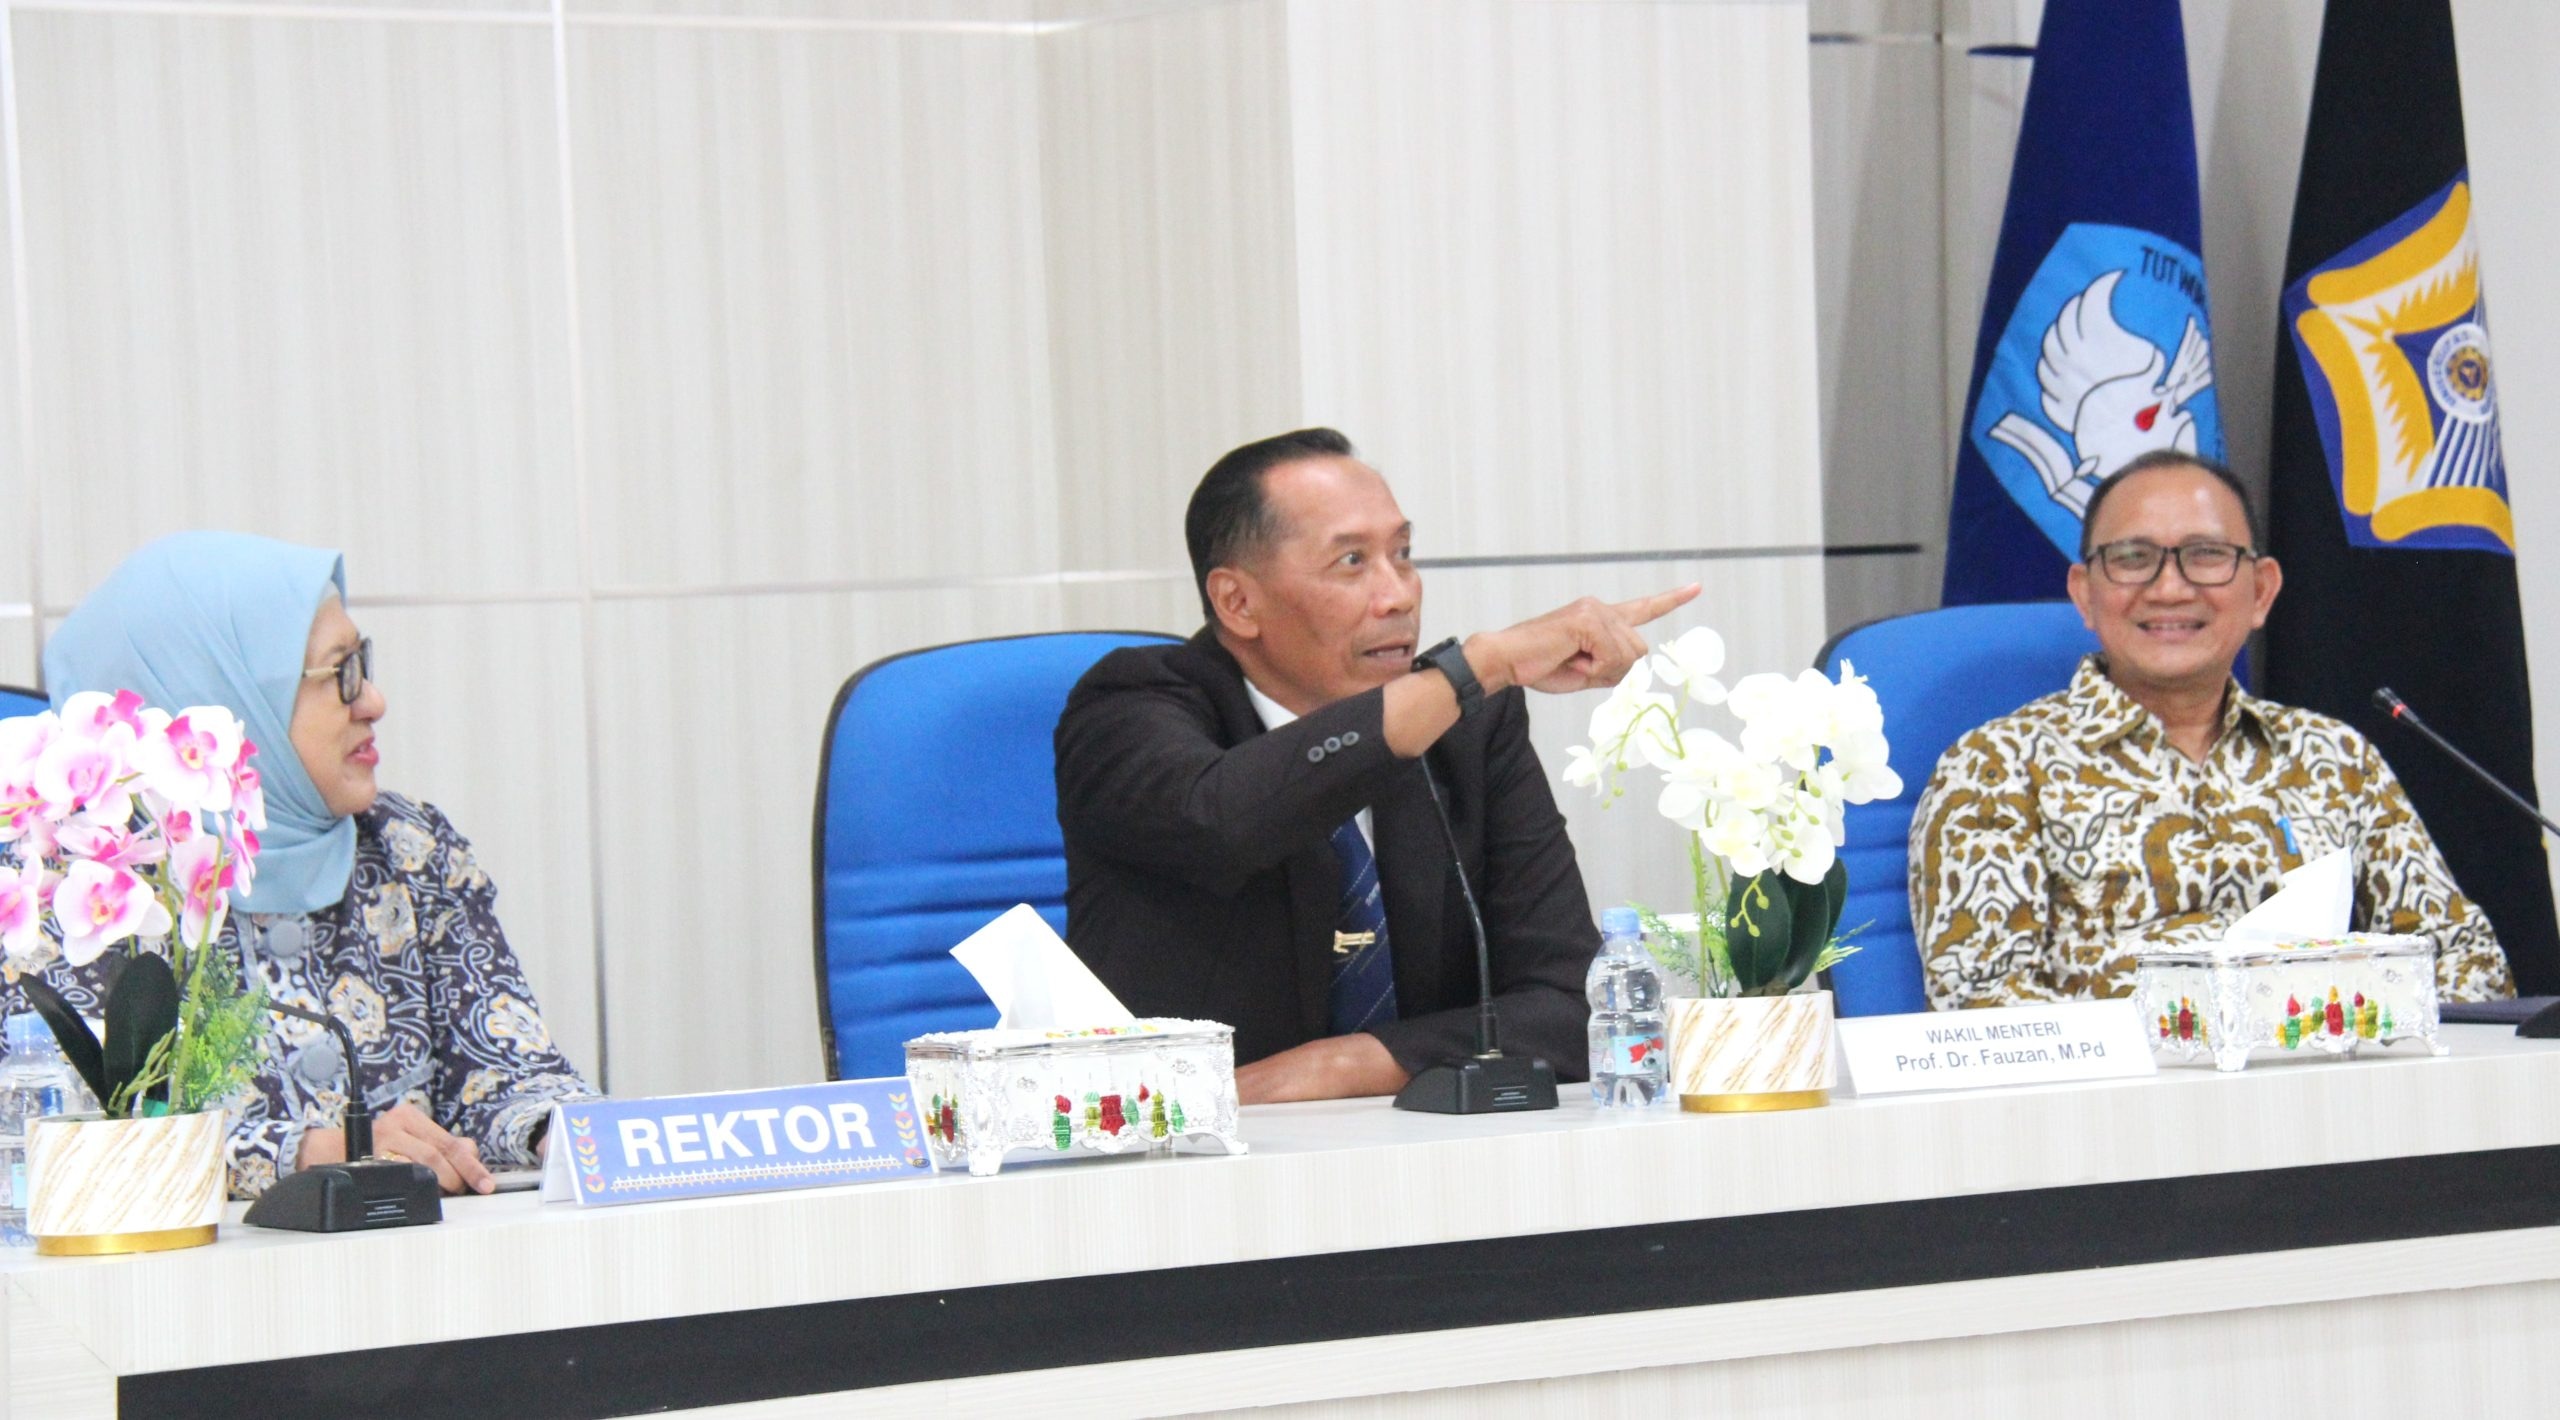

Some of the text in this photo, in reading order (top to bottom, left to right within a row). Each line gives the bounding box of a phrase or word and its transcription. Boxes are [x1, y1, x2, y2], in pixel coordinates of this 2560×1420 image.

[2141, 246, 2178, 284] TUT
[1926, 1020, 2062, 1044] WAKIL MENTERI
[1895, 1041, 2106, 1072] Prof. Dr. Fauzan, M.Pd
[617, 1102, 877, 1168] REKTOR
